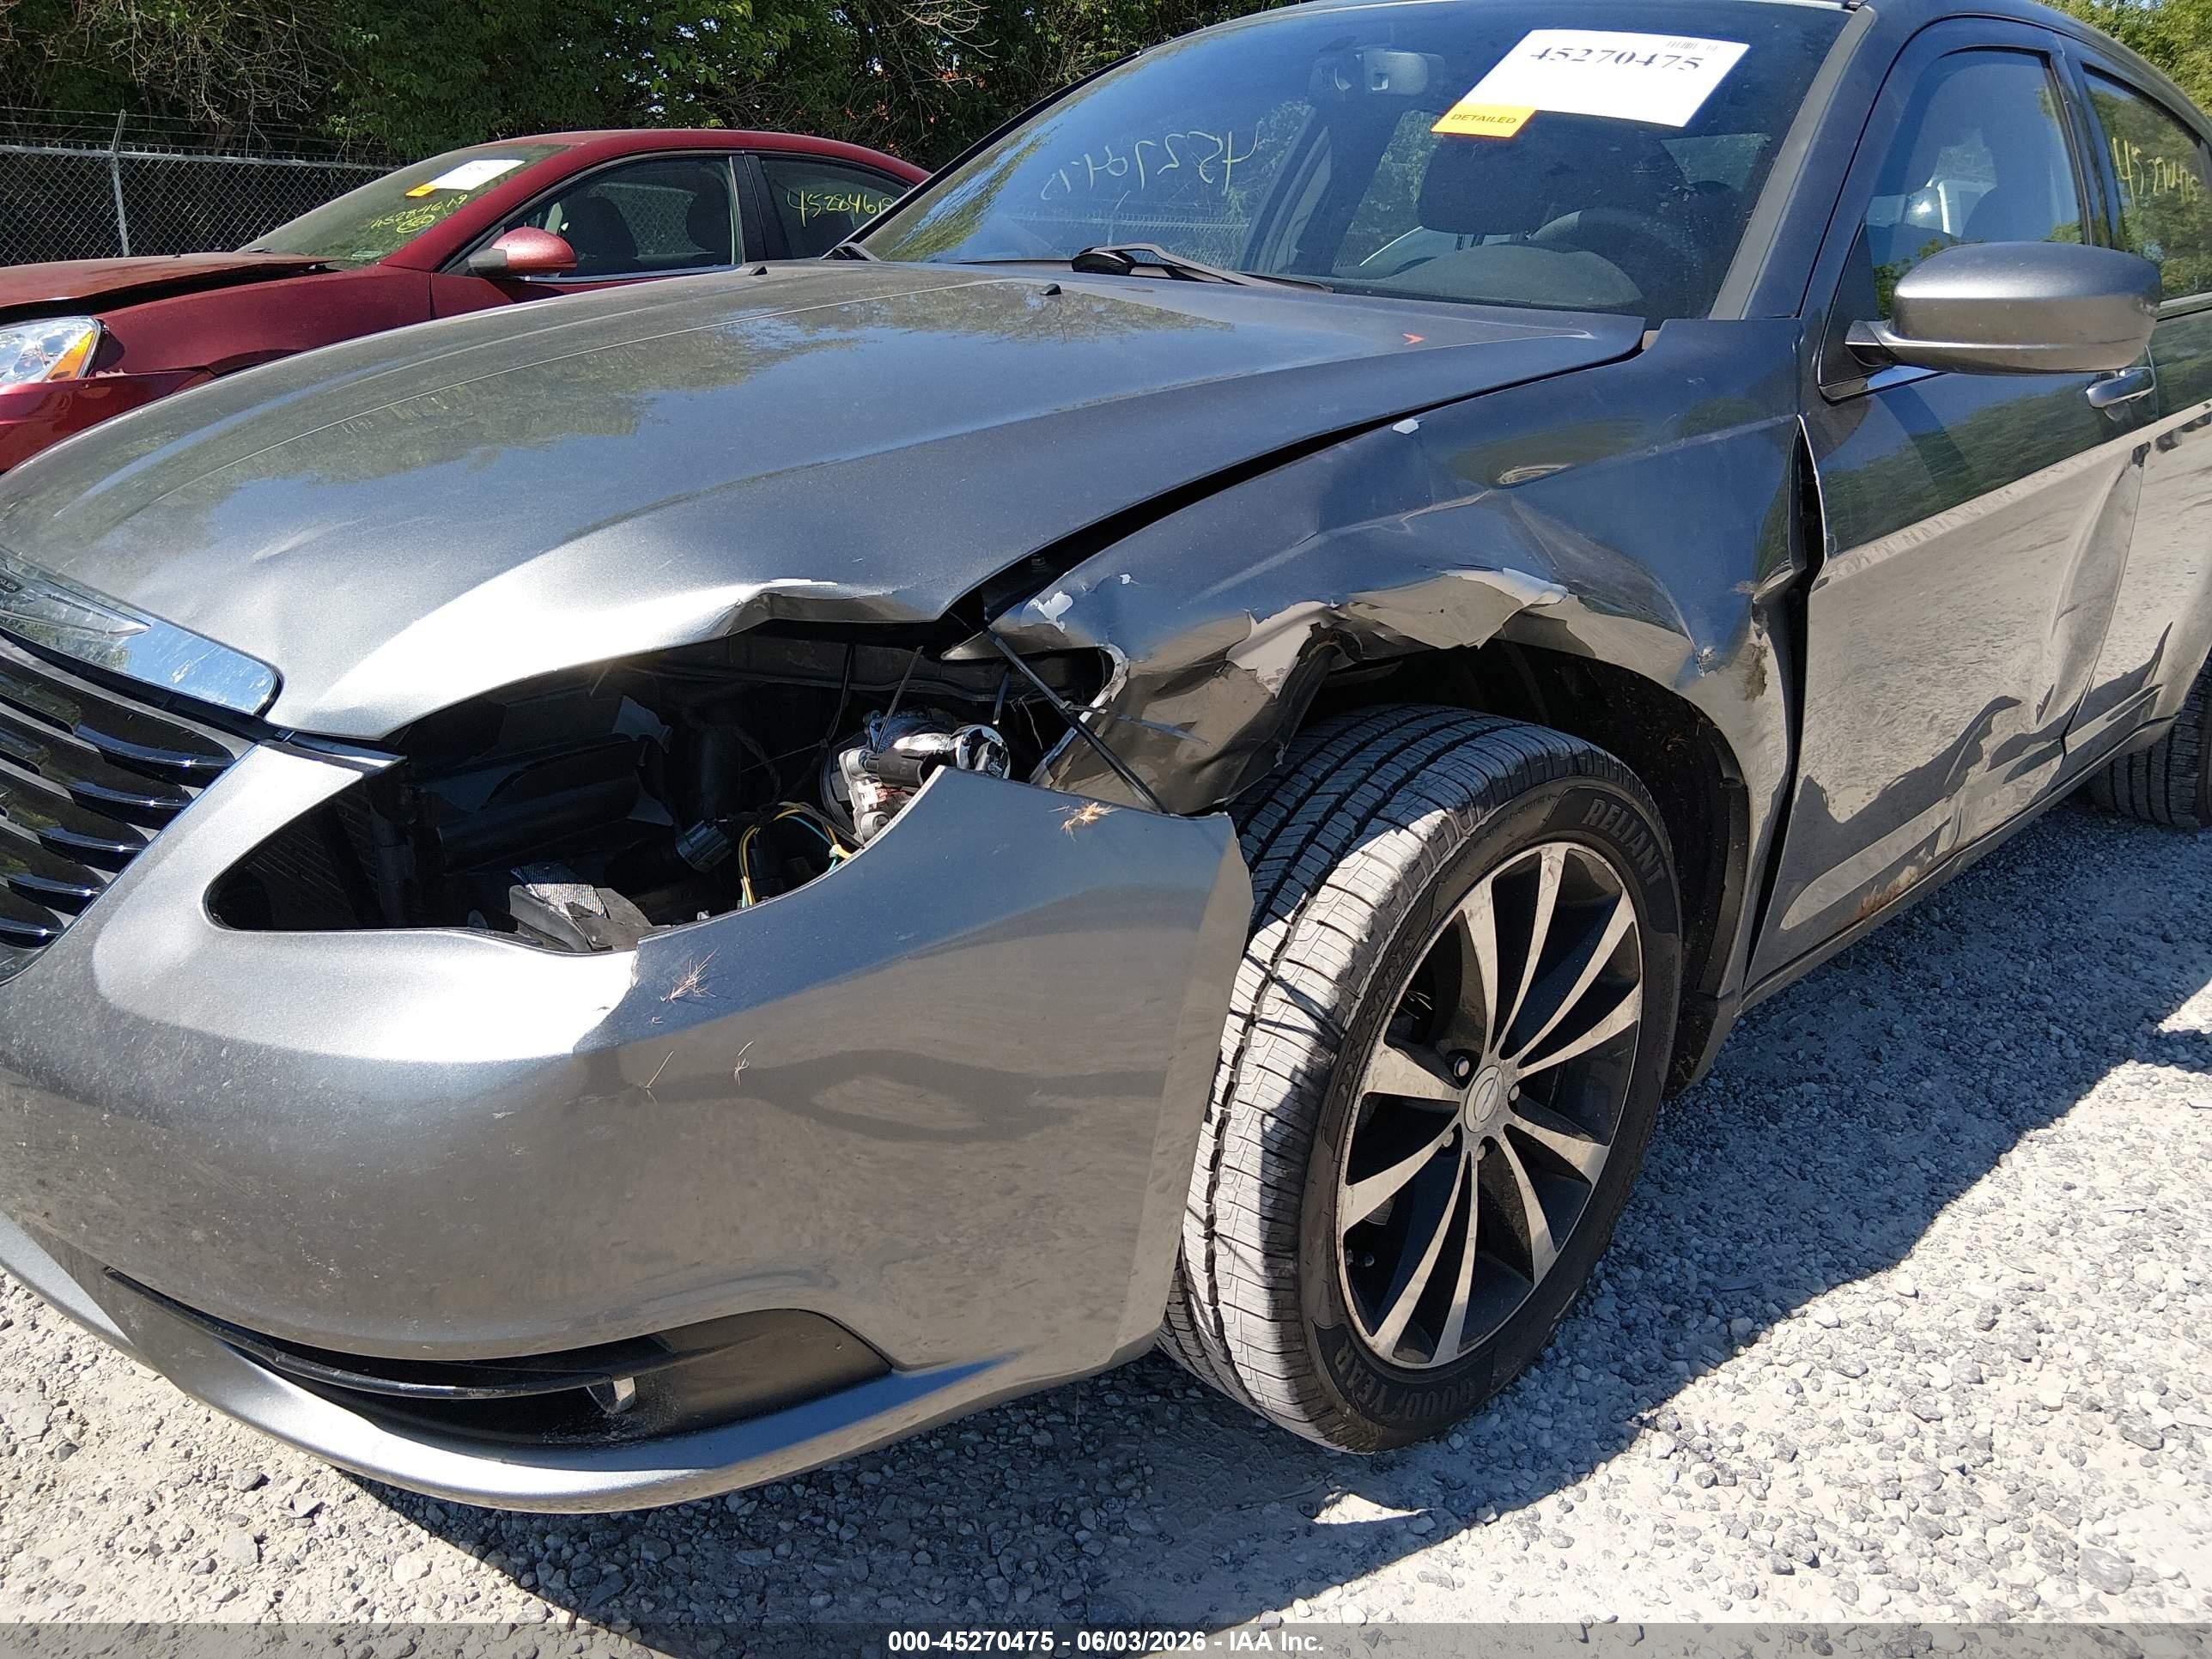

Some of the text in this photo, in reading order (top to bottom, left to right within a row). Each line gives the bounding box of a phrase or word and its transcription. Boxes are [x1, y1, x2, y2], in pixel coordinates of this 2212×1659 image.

[1529, 47, 1705, 71] 45270475
[1451, 113, 1517, 125] DETAILED
[1581, 798, 1668, 887] RELIANT
